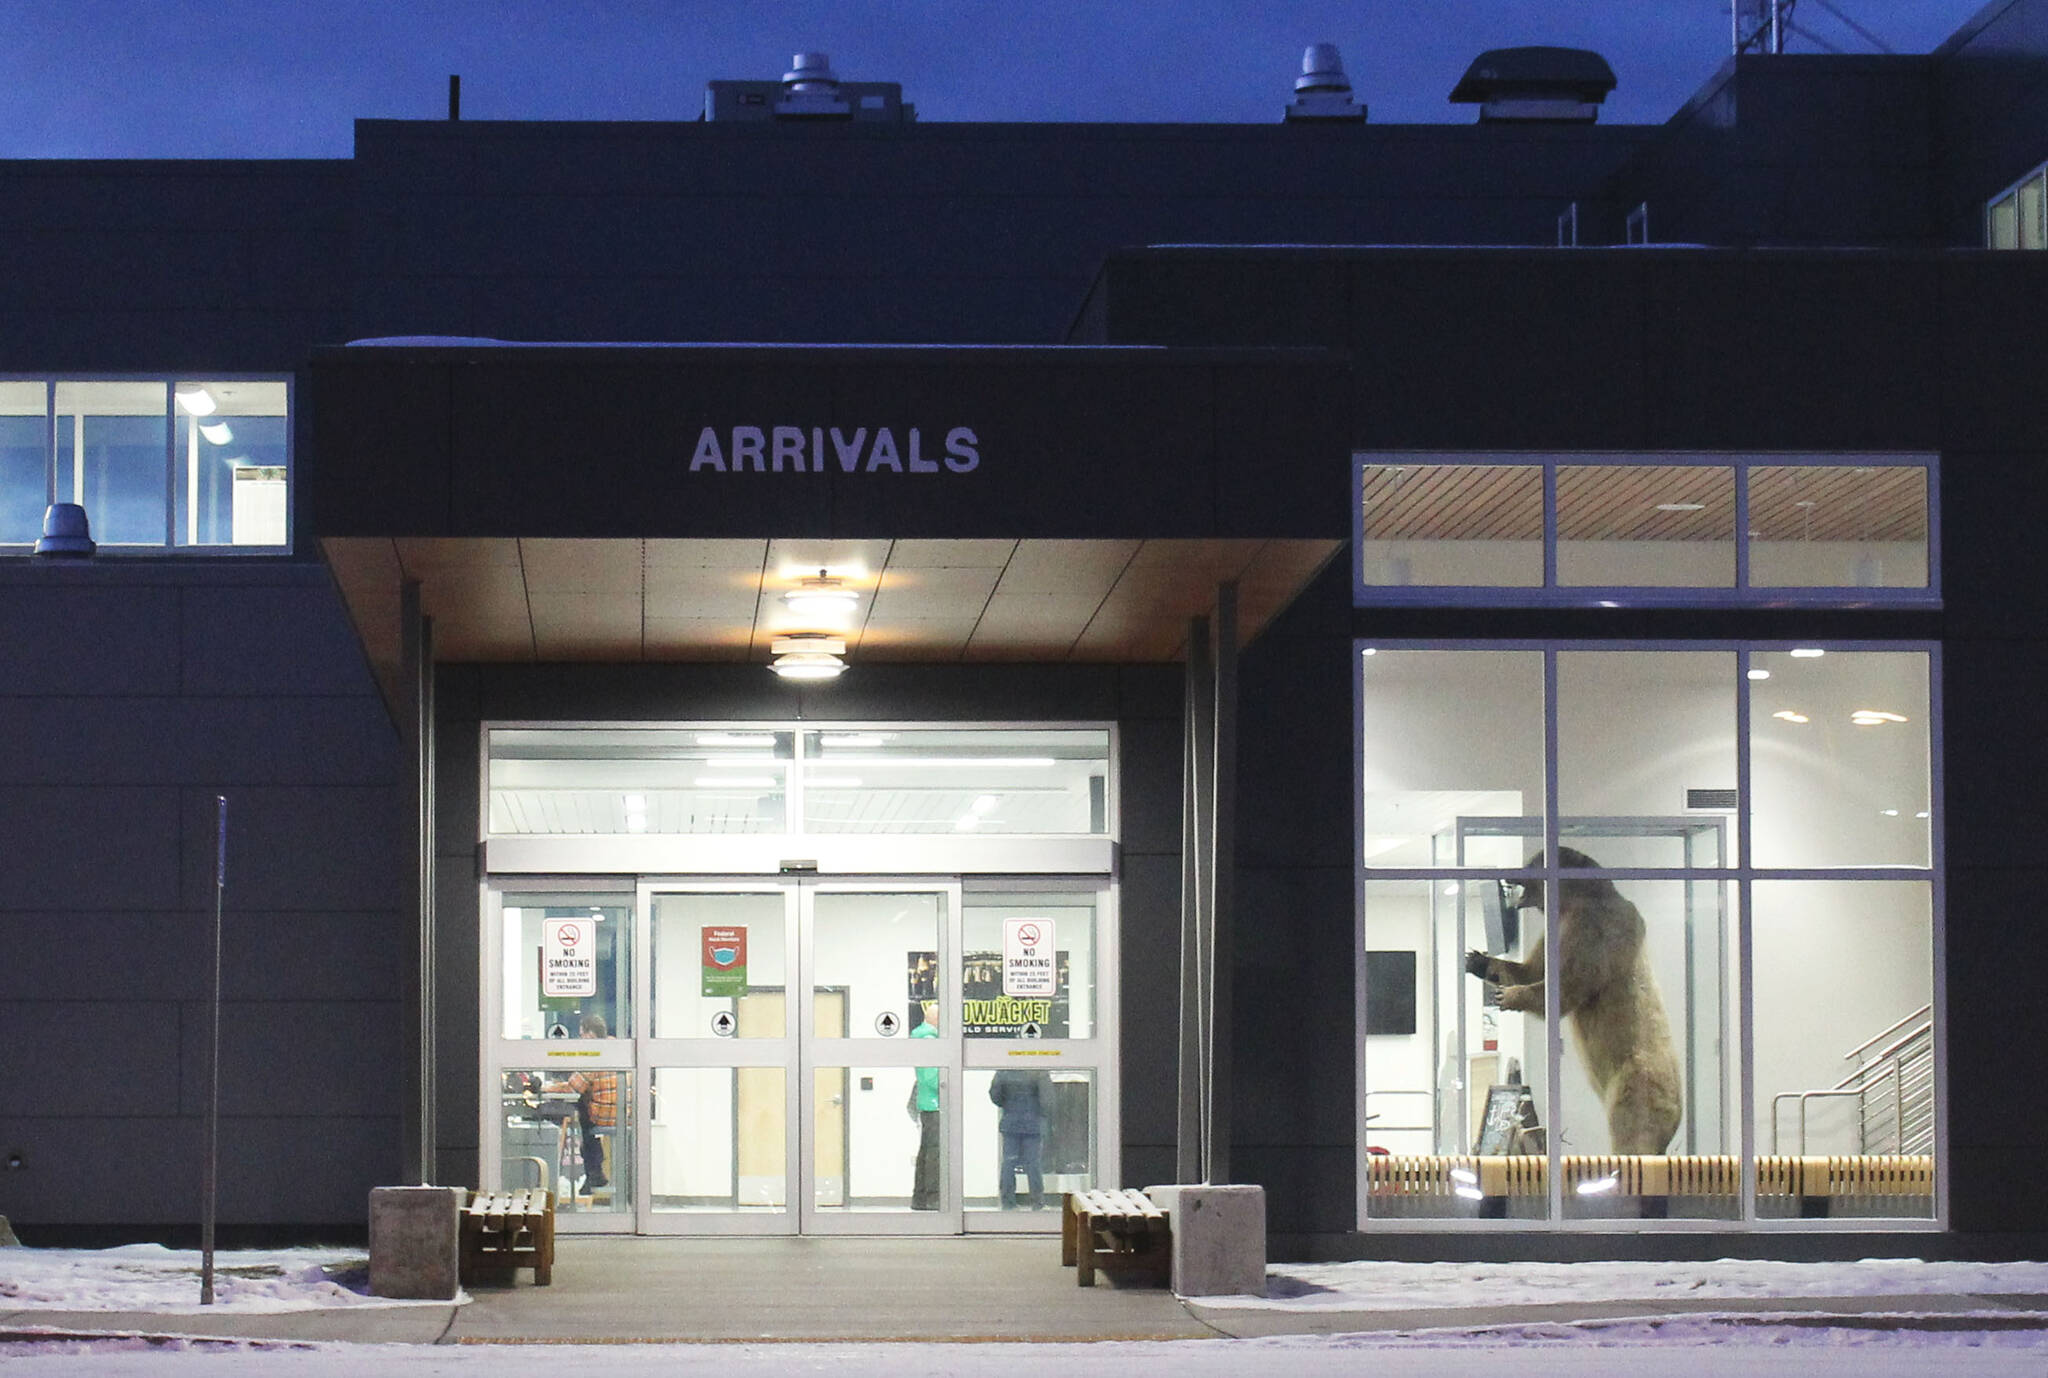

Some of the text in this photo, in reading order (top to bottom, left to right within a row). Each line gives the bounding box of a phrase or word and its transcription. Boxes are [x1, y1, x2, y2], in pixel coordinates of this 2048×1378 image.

[689, 426, 980, 473] ARRIVALS
[563, 948, 576, 957] NO
[1023, 948, 1036, 956] NO
[549, 959, 590, 968] SMOKING
[1009, 959, 1050, 968] SMOKING
[920, 998, 1051, 1025] OWJACKET
